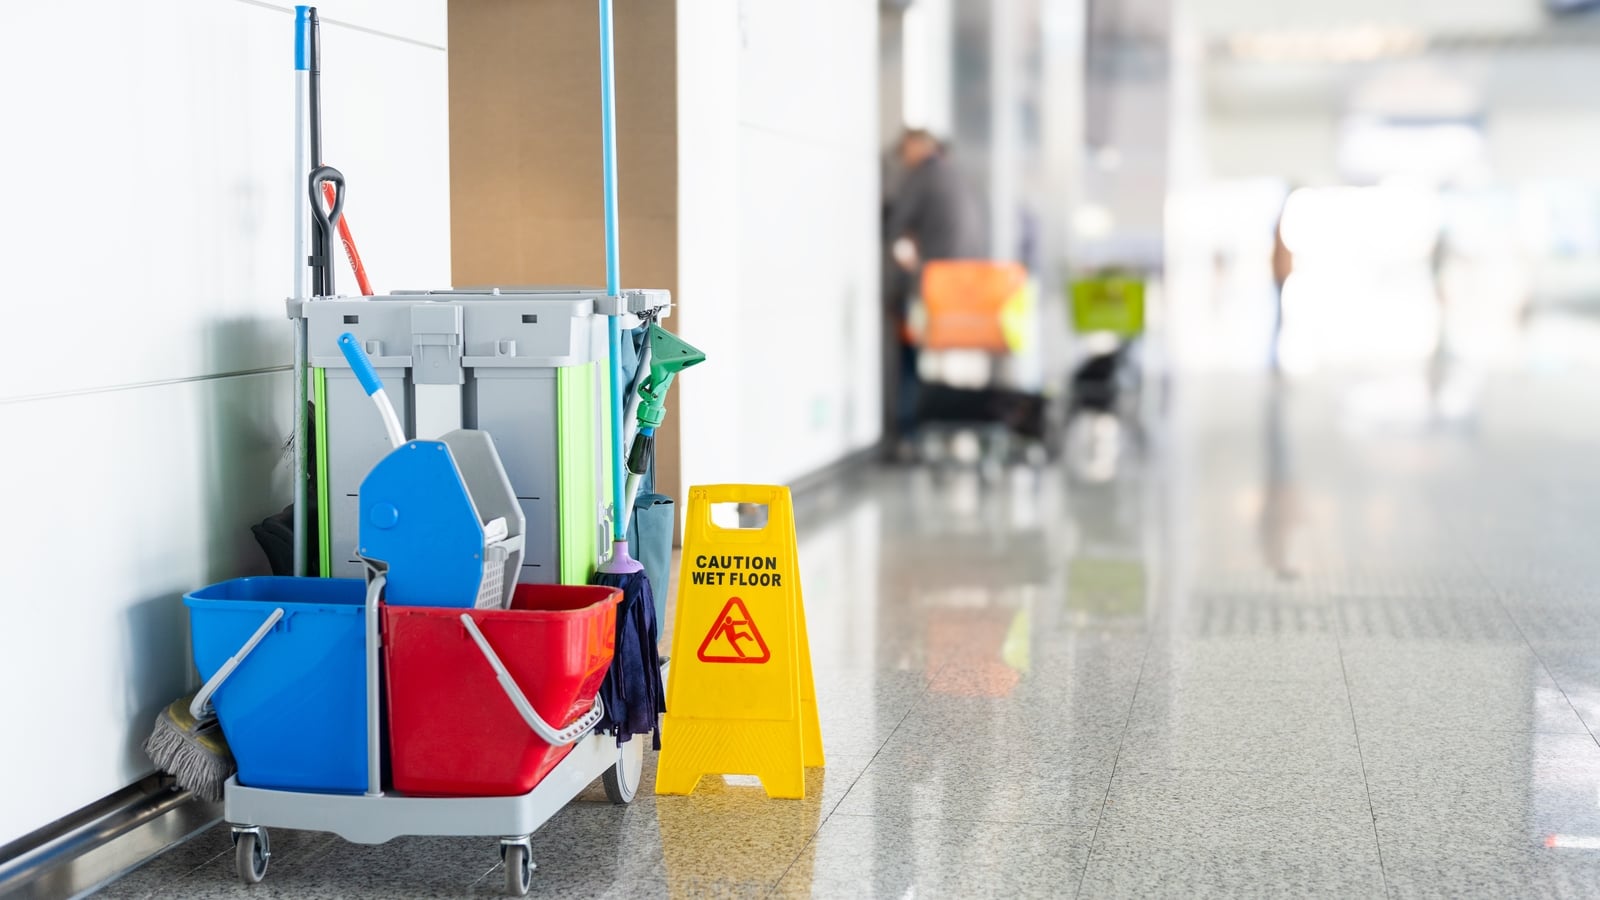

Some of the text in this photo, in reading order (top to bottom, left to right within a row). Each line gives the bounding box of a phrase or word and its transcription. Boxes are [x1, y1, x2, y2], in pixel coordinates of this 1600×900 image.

[696, 555, 777, 570] CAUTION
[692, 572, 782, 587] WET FLOOR
